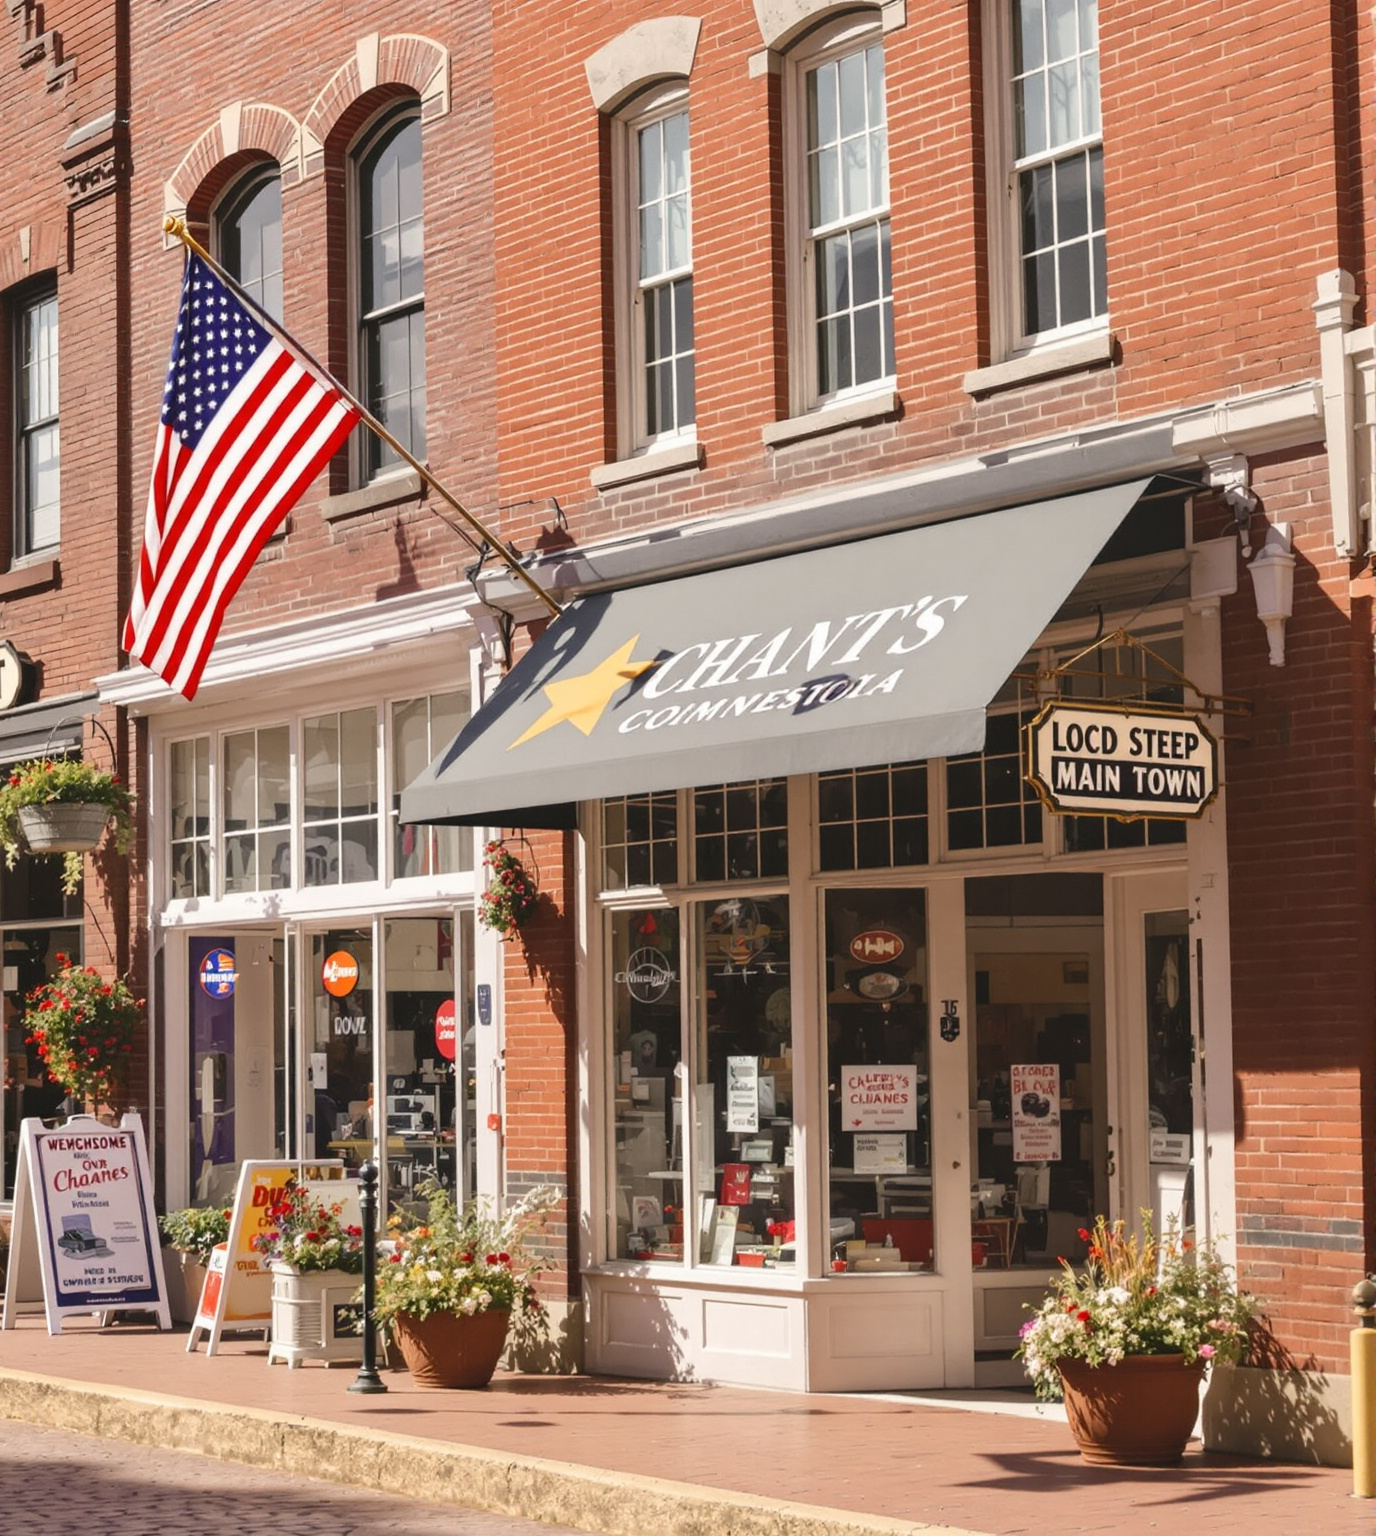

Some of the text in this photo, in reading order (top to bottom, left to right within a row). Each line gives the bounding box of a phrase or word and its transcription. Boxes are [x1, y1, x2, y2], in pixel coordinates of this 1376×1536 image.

[642, 595, 969, 699] CHANT'S
[1053, 720, 1199, 760] LOCD STEEP
[1056, 761, 1201, 799] MAIN TOWN
